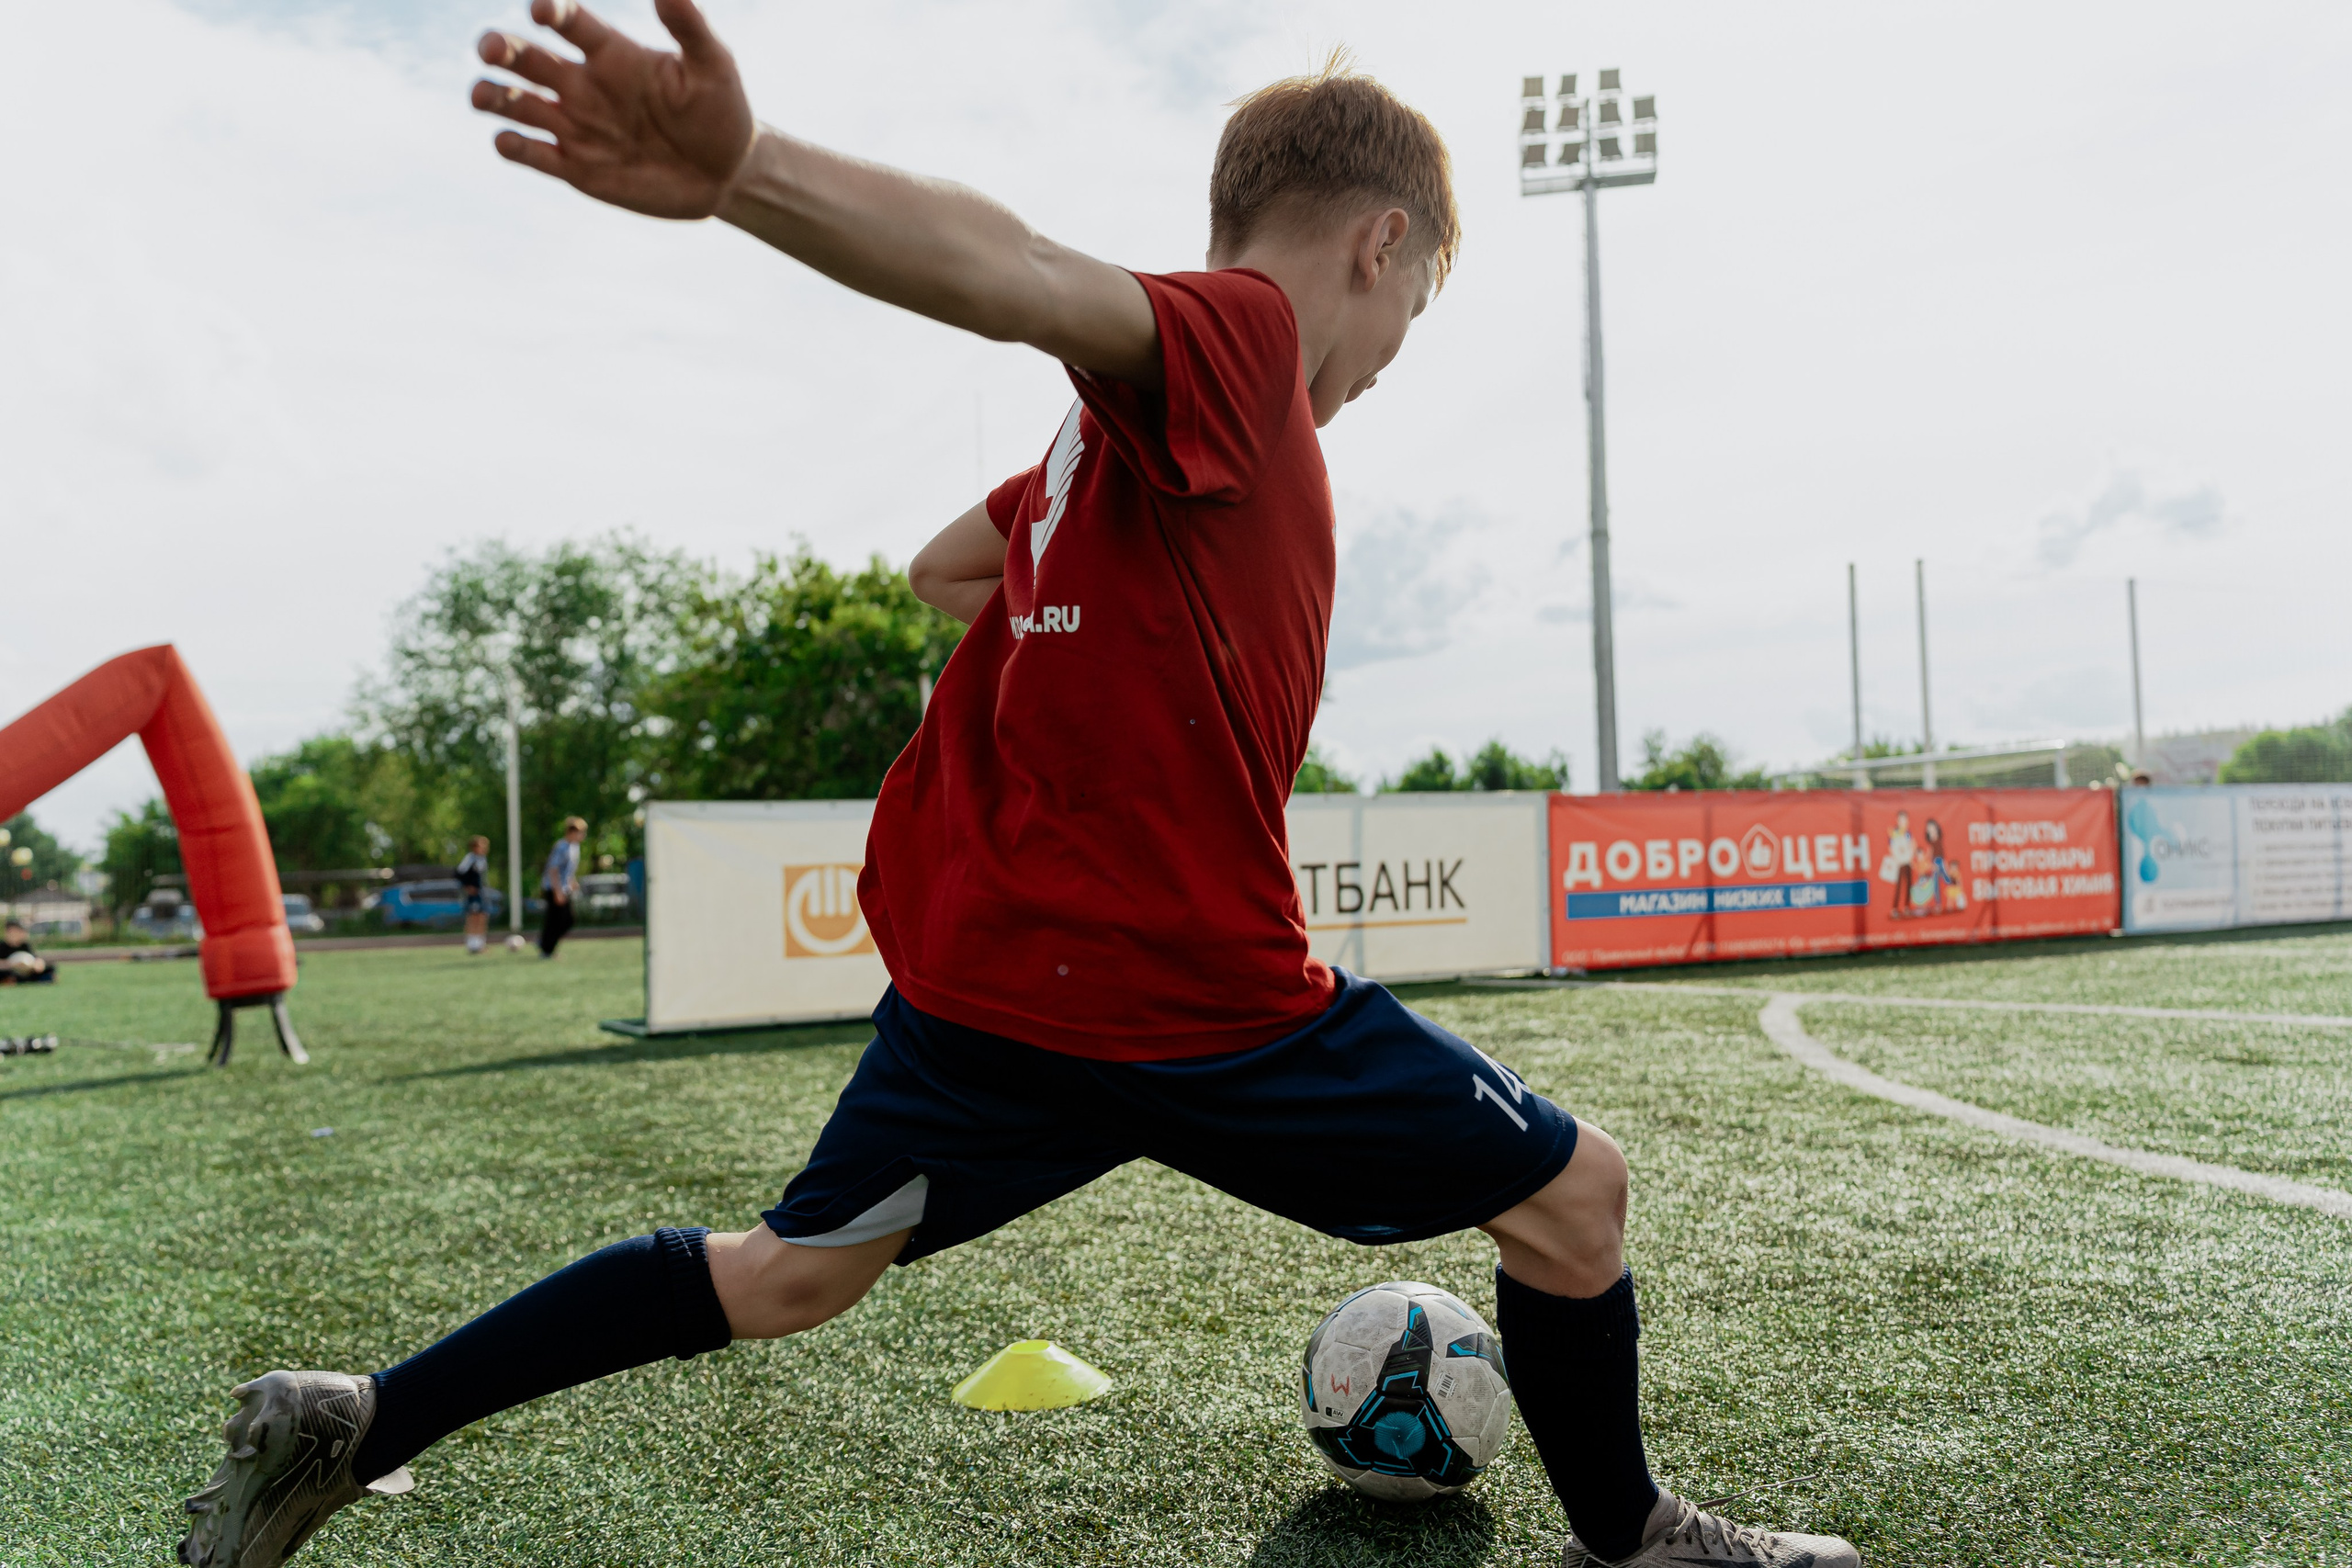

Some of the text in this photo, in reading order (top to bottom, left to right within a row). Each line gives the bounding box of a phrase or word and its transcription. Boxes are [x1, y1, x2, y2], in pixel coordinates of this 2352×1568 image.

[1968, 820, 2067, 846] ПРОДУКТЫ
[1970, 847, 2095, 872] ПРОМТОВАРЫ
[1300, 858, 1465, 915] ТБАНК
[1619, 886, 1827, 915] МАГАЗИН НИЗКИХ ЦЕН
[1973, 874, 2060, 901] БЫТОВАЯ
[1471, 1045, 1532, 1132] 14
